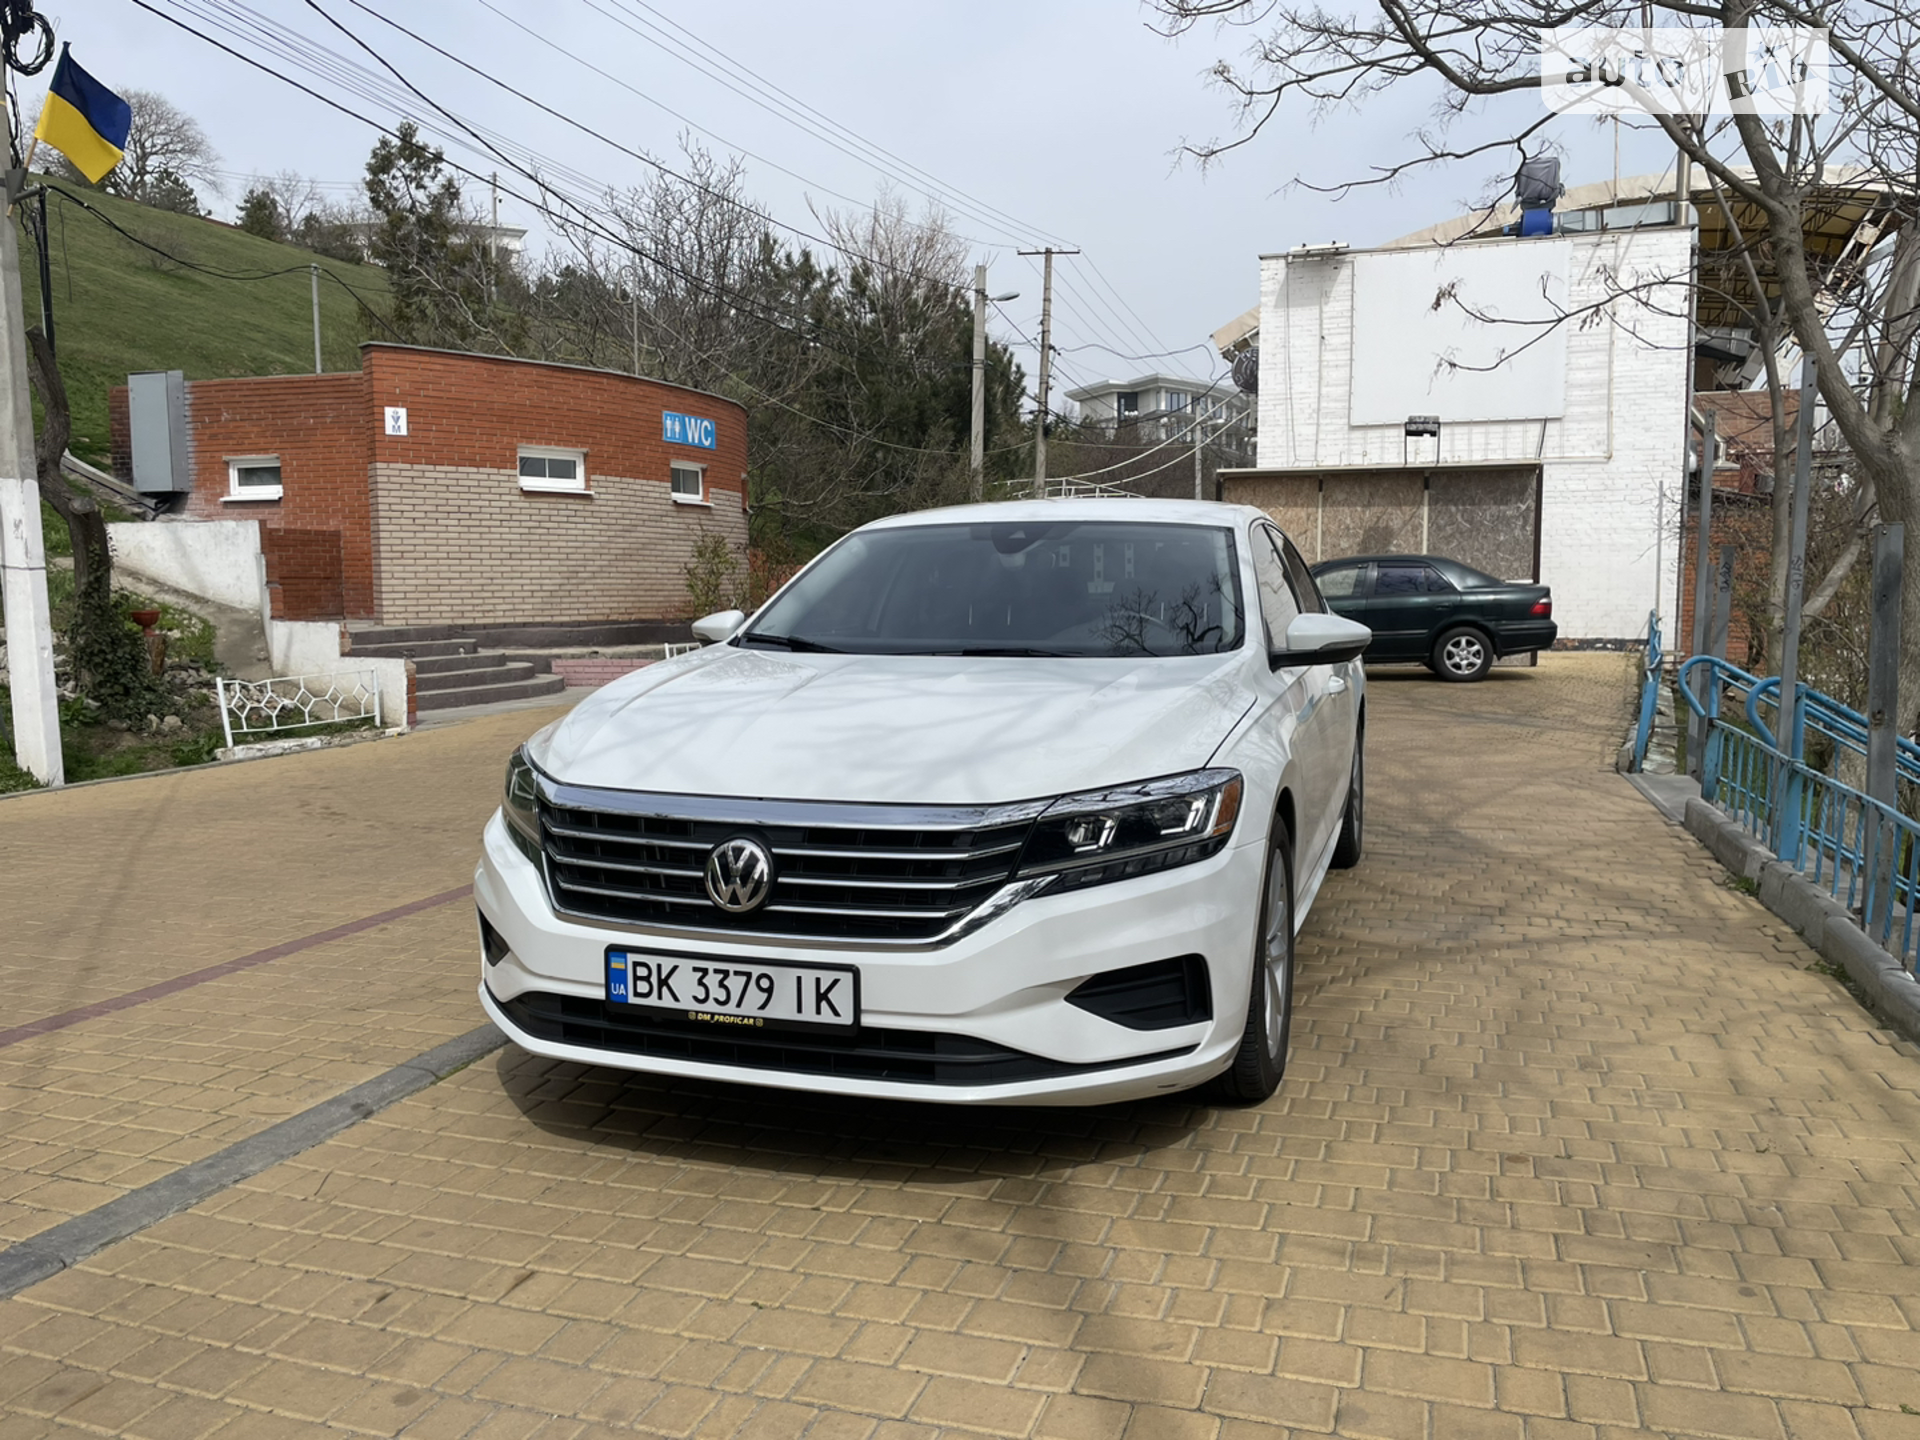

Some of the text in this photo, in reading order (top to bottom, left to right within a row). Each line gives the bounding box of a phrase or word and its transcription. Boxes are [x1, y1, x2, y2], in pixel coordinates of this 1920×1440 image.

[685, 416, 712, 446] WC
[611, 983, 627, 996] UA
[631, 960, 842, 1018] BK 3379 IK
